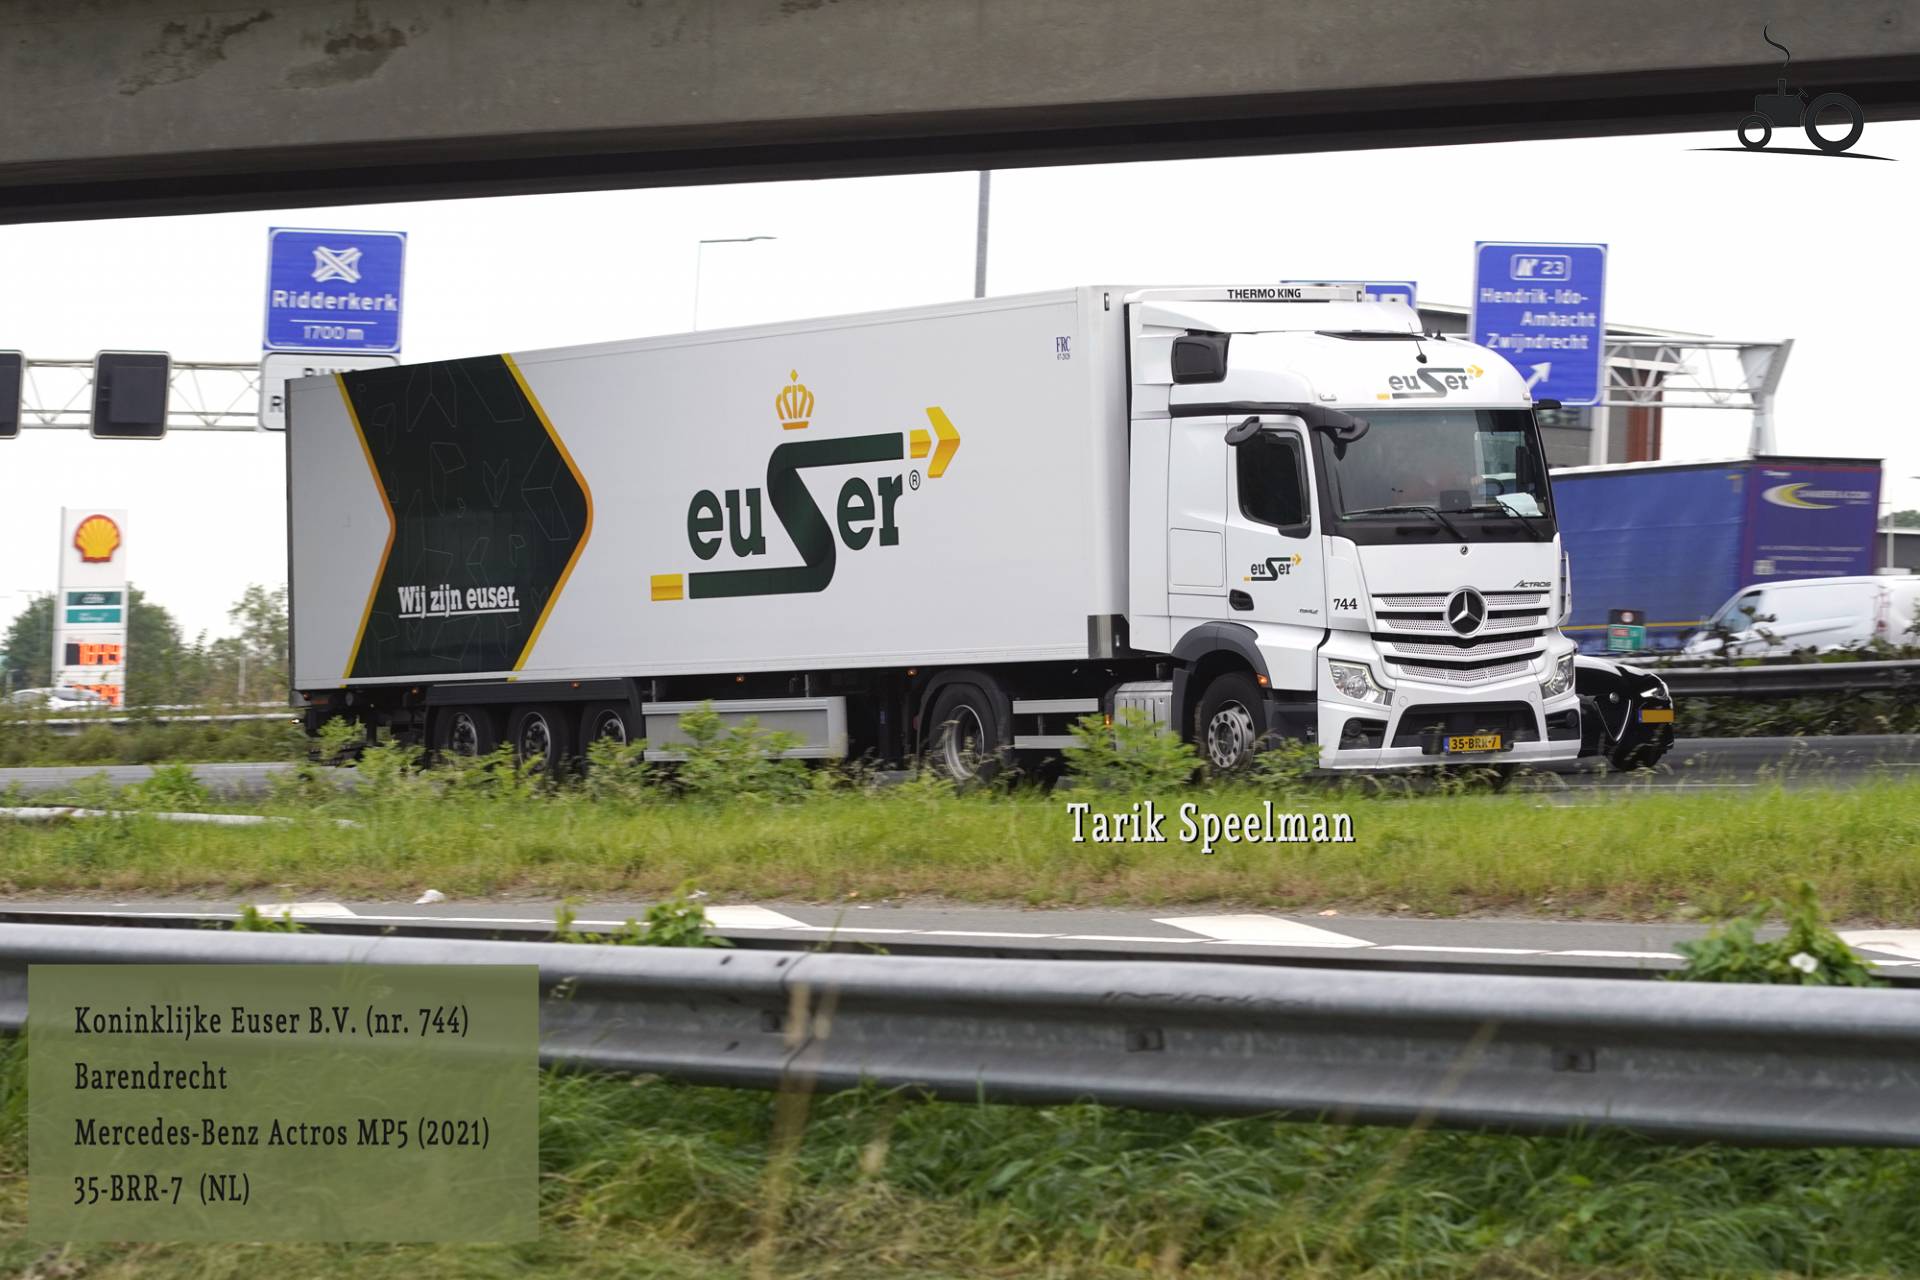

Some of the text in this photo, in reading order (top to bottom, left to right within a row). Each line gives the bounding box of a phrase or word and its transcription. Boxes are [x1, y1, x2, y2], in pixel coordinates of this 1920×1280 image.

[1540, 260, 1565, 275] 23
[271, 290, 399, 312] Ridderkerk
[1227, 288, 1302, 299] THERMO KING
[1519, 310, 1598, 328] Ambacht
[303, 325, 365, 341] 1700 m
[1056, 336, 1072, 353] FRC
[1486, 332, 1590, 354] Zwijndrecht
[398, 584, 520, 619] Wij zijn euser.
[1333, 598, 1358, 610] 744
